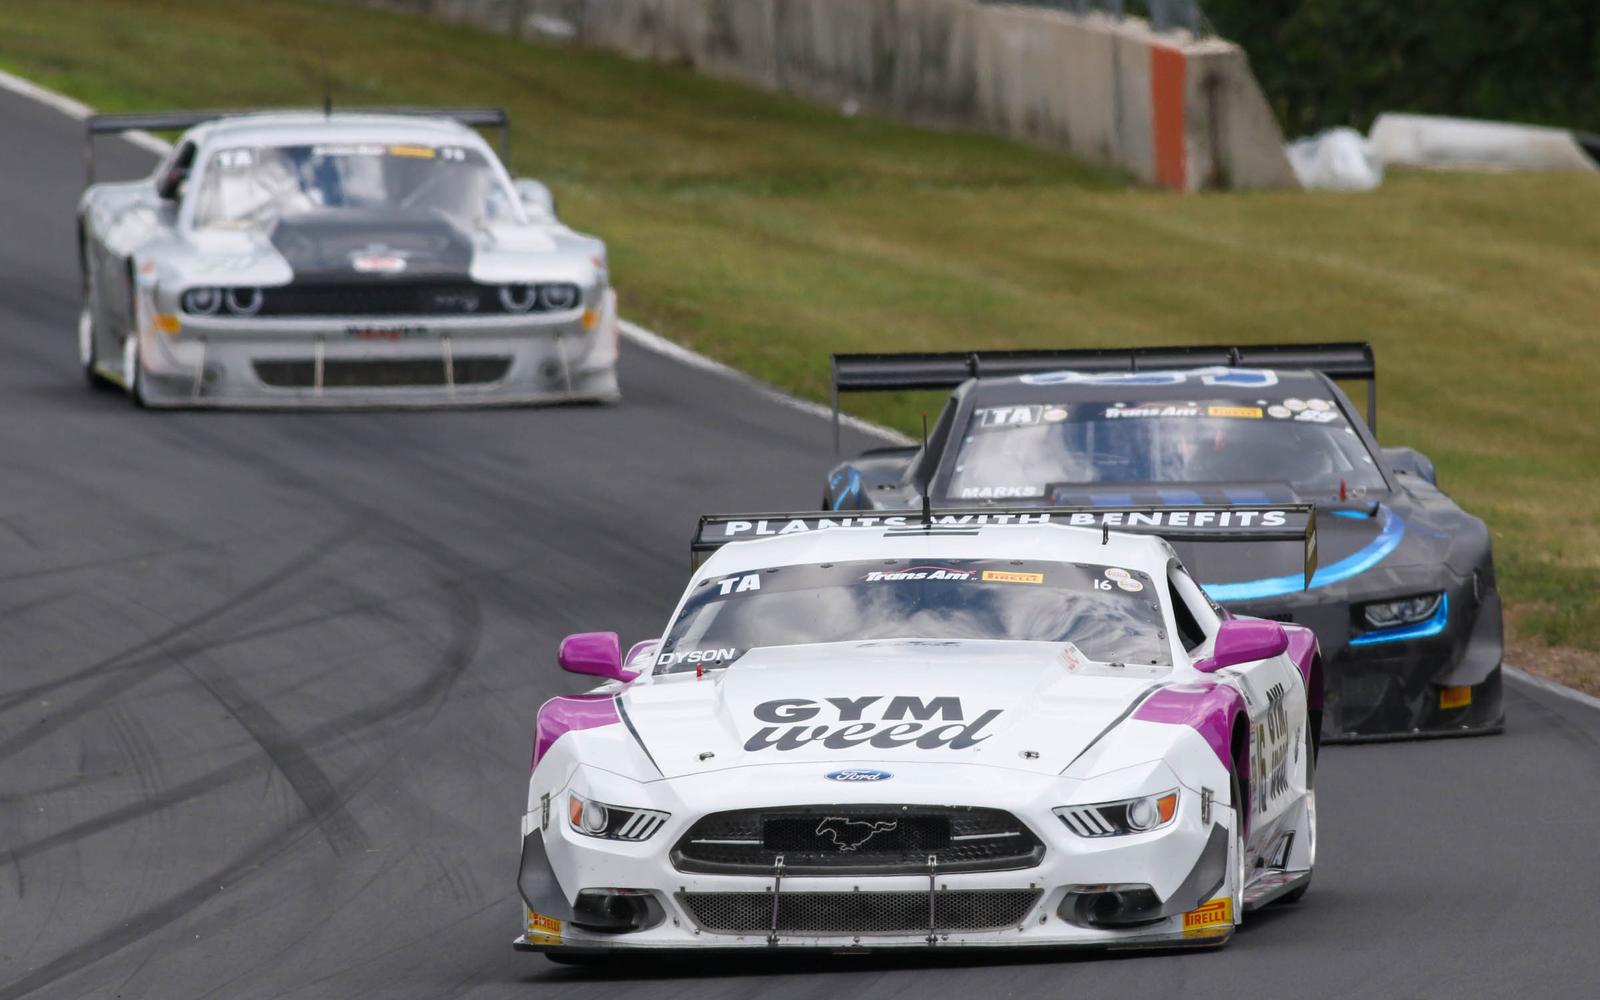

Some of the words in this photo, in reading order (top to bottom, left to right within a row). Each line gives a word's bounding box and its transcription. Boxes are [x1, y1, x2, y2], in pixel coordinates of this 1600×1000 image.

[993, 407, 1032, 424] TA
[962, 486, 1037, 498] MARKS
[725, 516, 907, 536] PLANTS
[928, 514, 1051, 525] WITH
[1069, 511, 1286, 526] BENEFITS
[718, 574, 761, 595] TA
[1094, 579, 1112, 590] 16
[658, 648, 736, 666] DYSON
[753, 696, 964, 724] GYM
[744, 709, 1005, 752] weed
[836, 770, 881, 783] Ford
